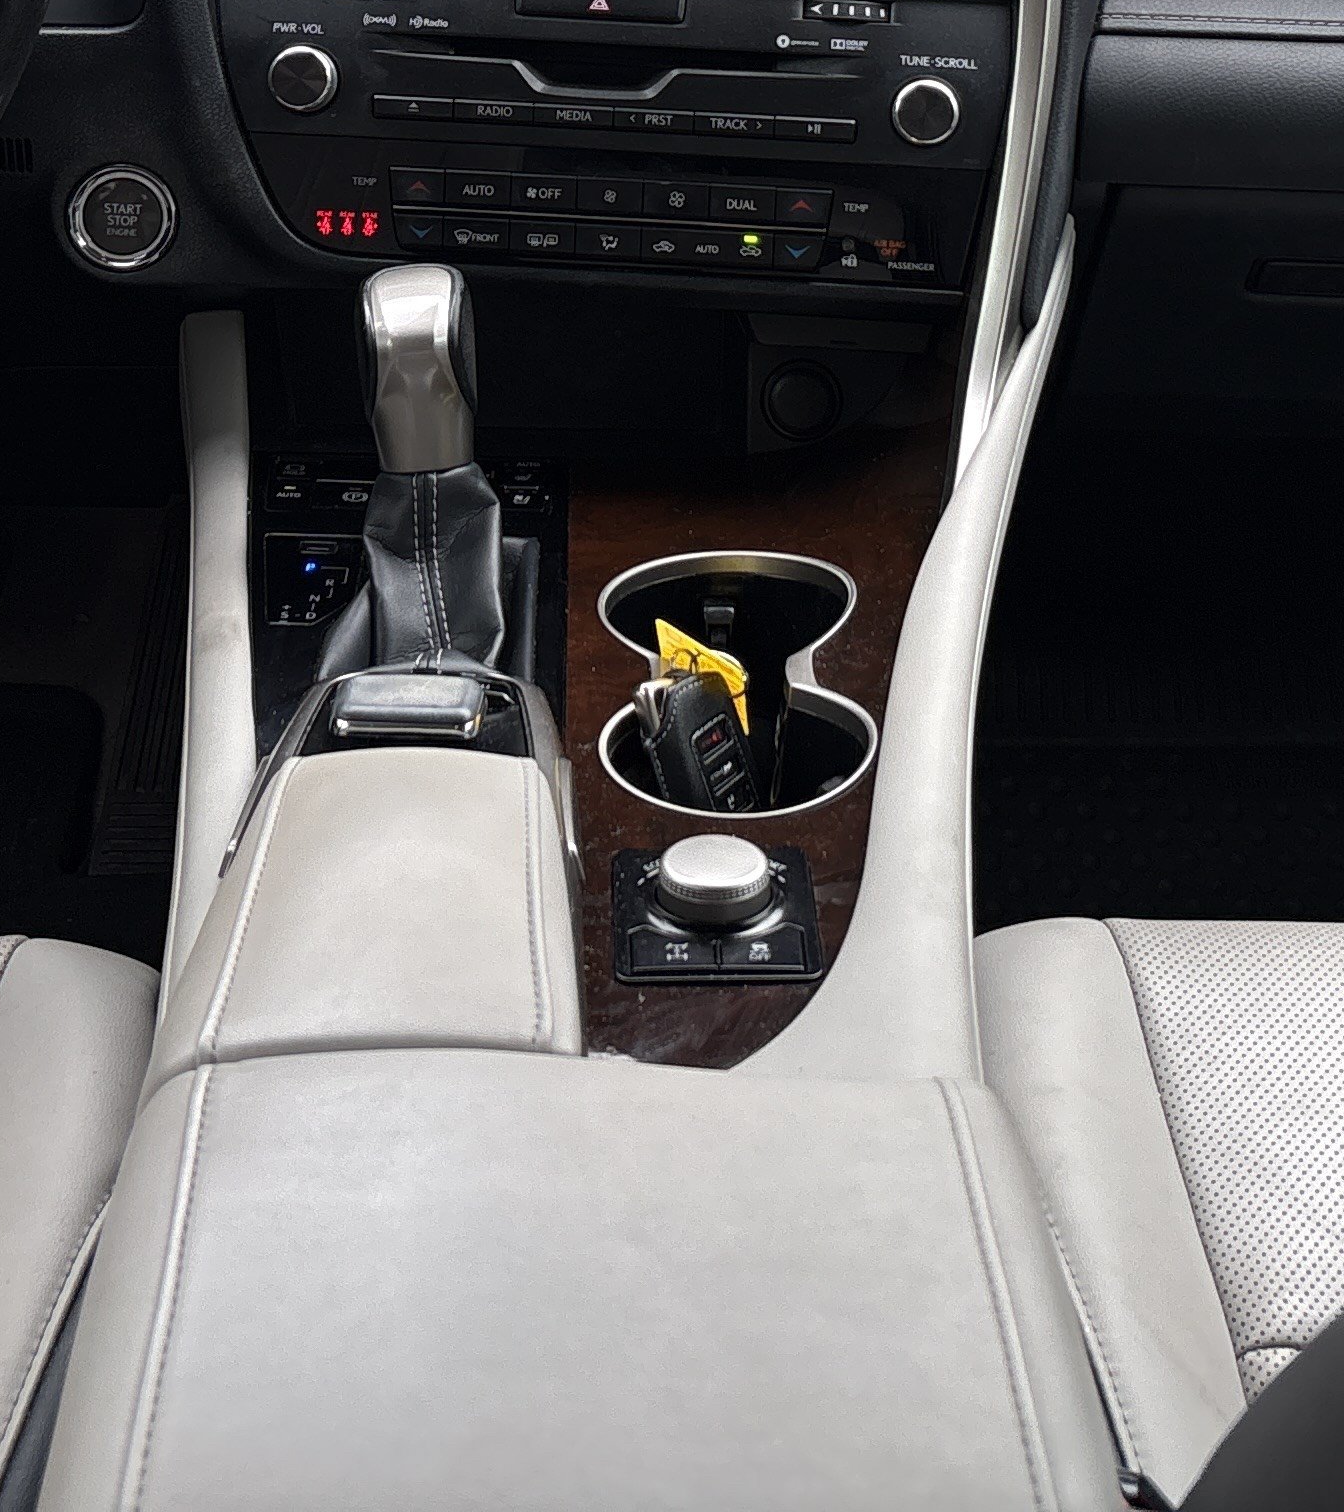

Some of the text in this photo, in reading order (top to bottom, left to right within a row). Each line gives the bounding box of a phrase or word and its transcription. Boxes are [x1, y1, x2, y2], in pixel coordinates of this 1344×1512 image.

[423, 18, 449, 28] Radio
[477, 104, 513, 118] RADIO
[555, 109, 593, 122] MEDIA
[644, 113, 673, 126] PRST
[709, 118, 748, 131] TRACK
[352, 176, 378, 187] TEMP
[462, 184, 495, 197] AUTO
[538, 187, 563, 199] OFF
[103, 202, 143, 215] START
[726, 198, 758, 211] DUAL
[843, 202, 869, 214] TEMP
[107, 215, 138, 226] STOP
[106, 228, 138, 237] ENGINE
[471, 232, 499, 243] FRONT
[695, 244, 719, 255] AUTO
[887, 261, 936, 272] PASSENGER
[305, 562, 316, 572] P
[325, 578, 335, 587] R
[308, 593, 321, 602] N
[306, 612, 317, 620] D
